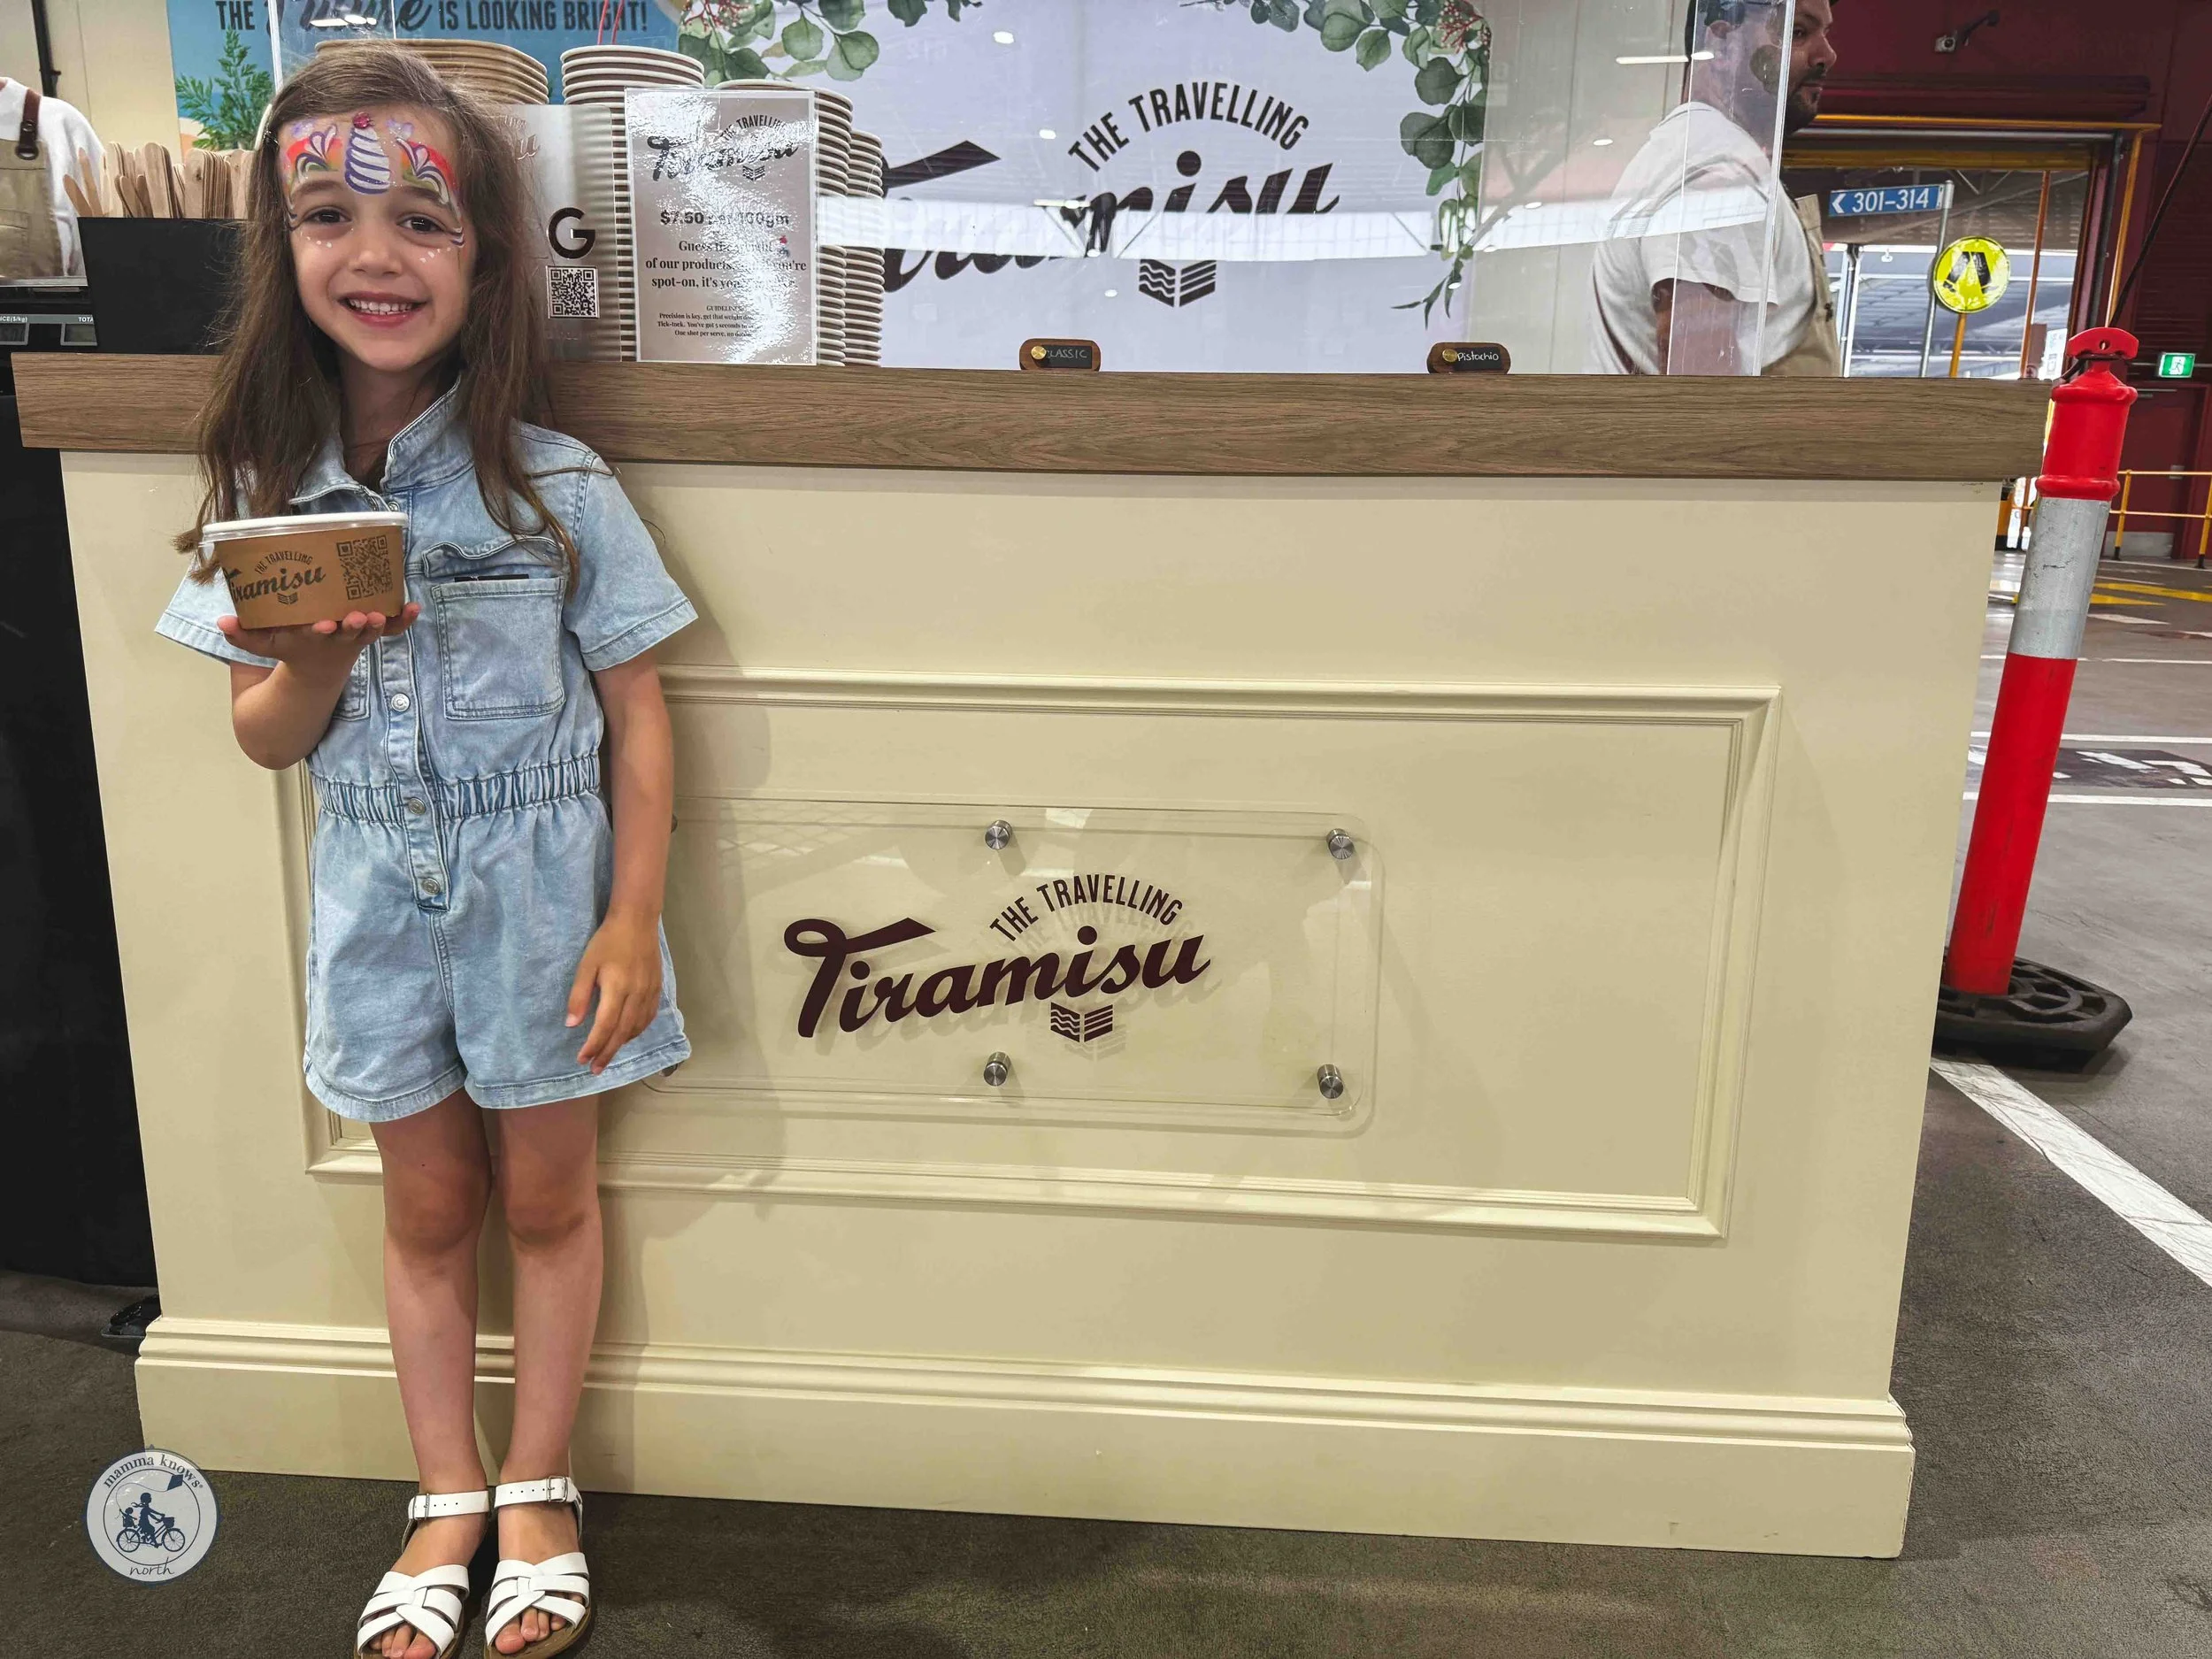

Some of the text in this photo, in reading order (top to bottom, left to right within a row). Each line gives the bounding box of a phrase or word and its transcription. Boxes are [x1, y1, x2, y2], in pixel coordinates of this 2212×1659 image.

[215, 1, 256, 30] THE
[439, 2, 458, 30] IS
[466, 1, 556, 31] LOOKING
[563, 1, 648, 32] BRIGHT!
[1067, 81, 1310, 173] THE TRAVELLING
[1851, 188, 1930, 213] 301-314
[548, 207, 596, 259] G
[645, 257, 658, 269] of
[659, 259, 680, 269] our
[651, 276, 699, 288] spot-on,
[702, 276, 718, 288] it's
[265, 549, 313, 565] TRAVELLING
[989, 874, 1184, 942] THE TRAVELLING
[784, 917, 1211, 1039] Tiramisu
